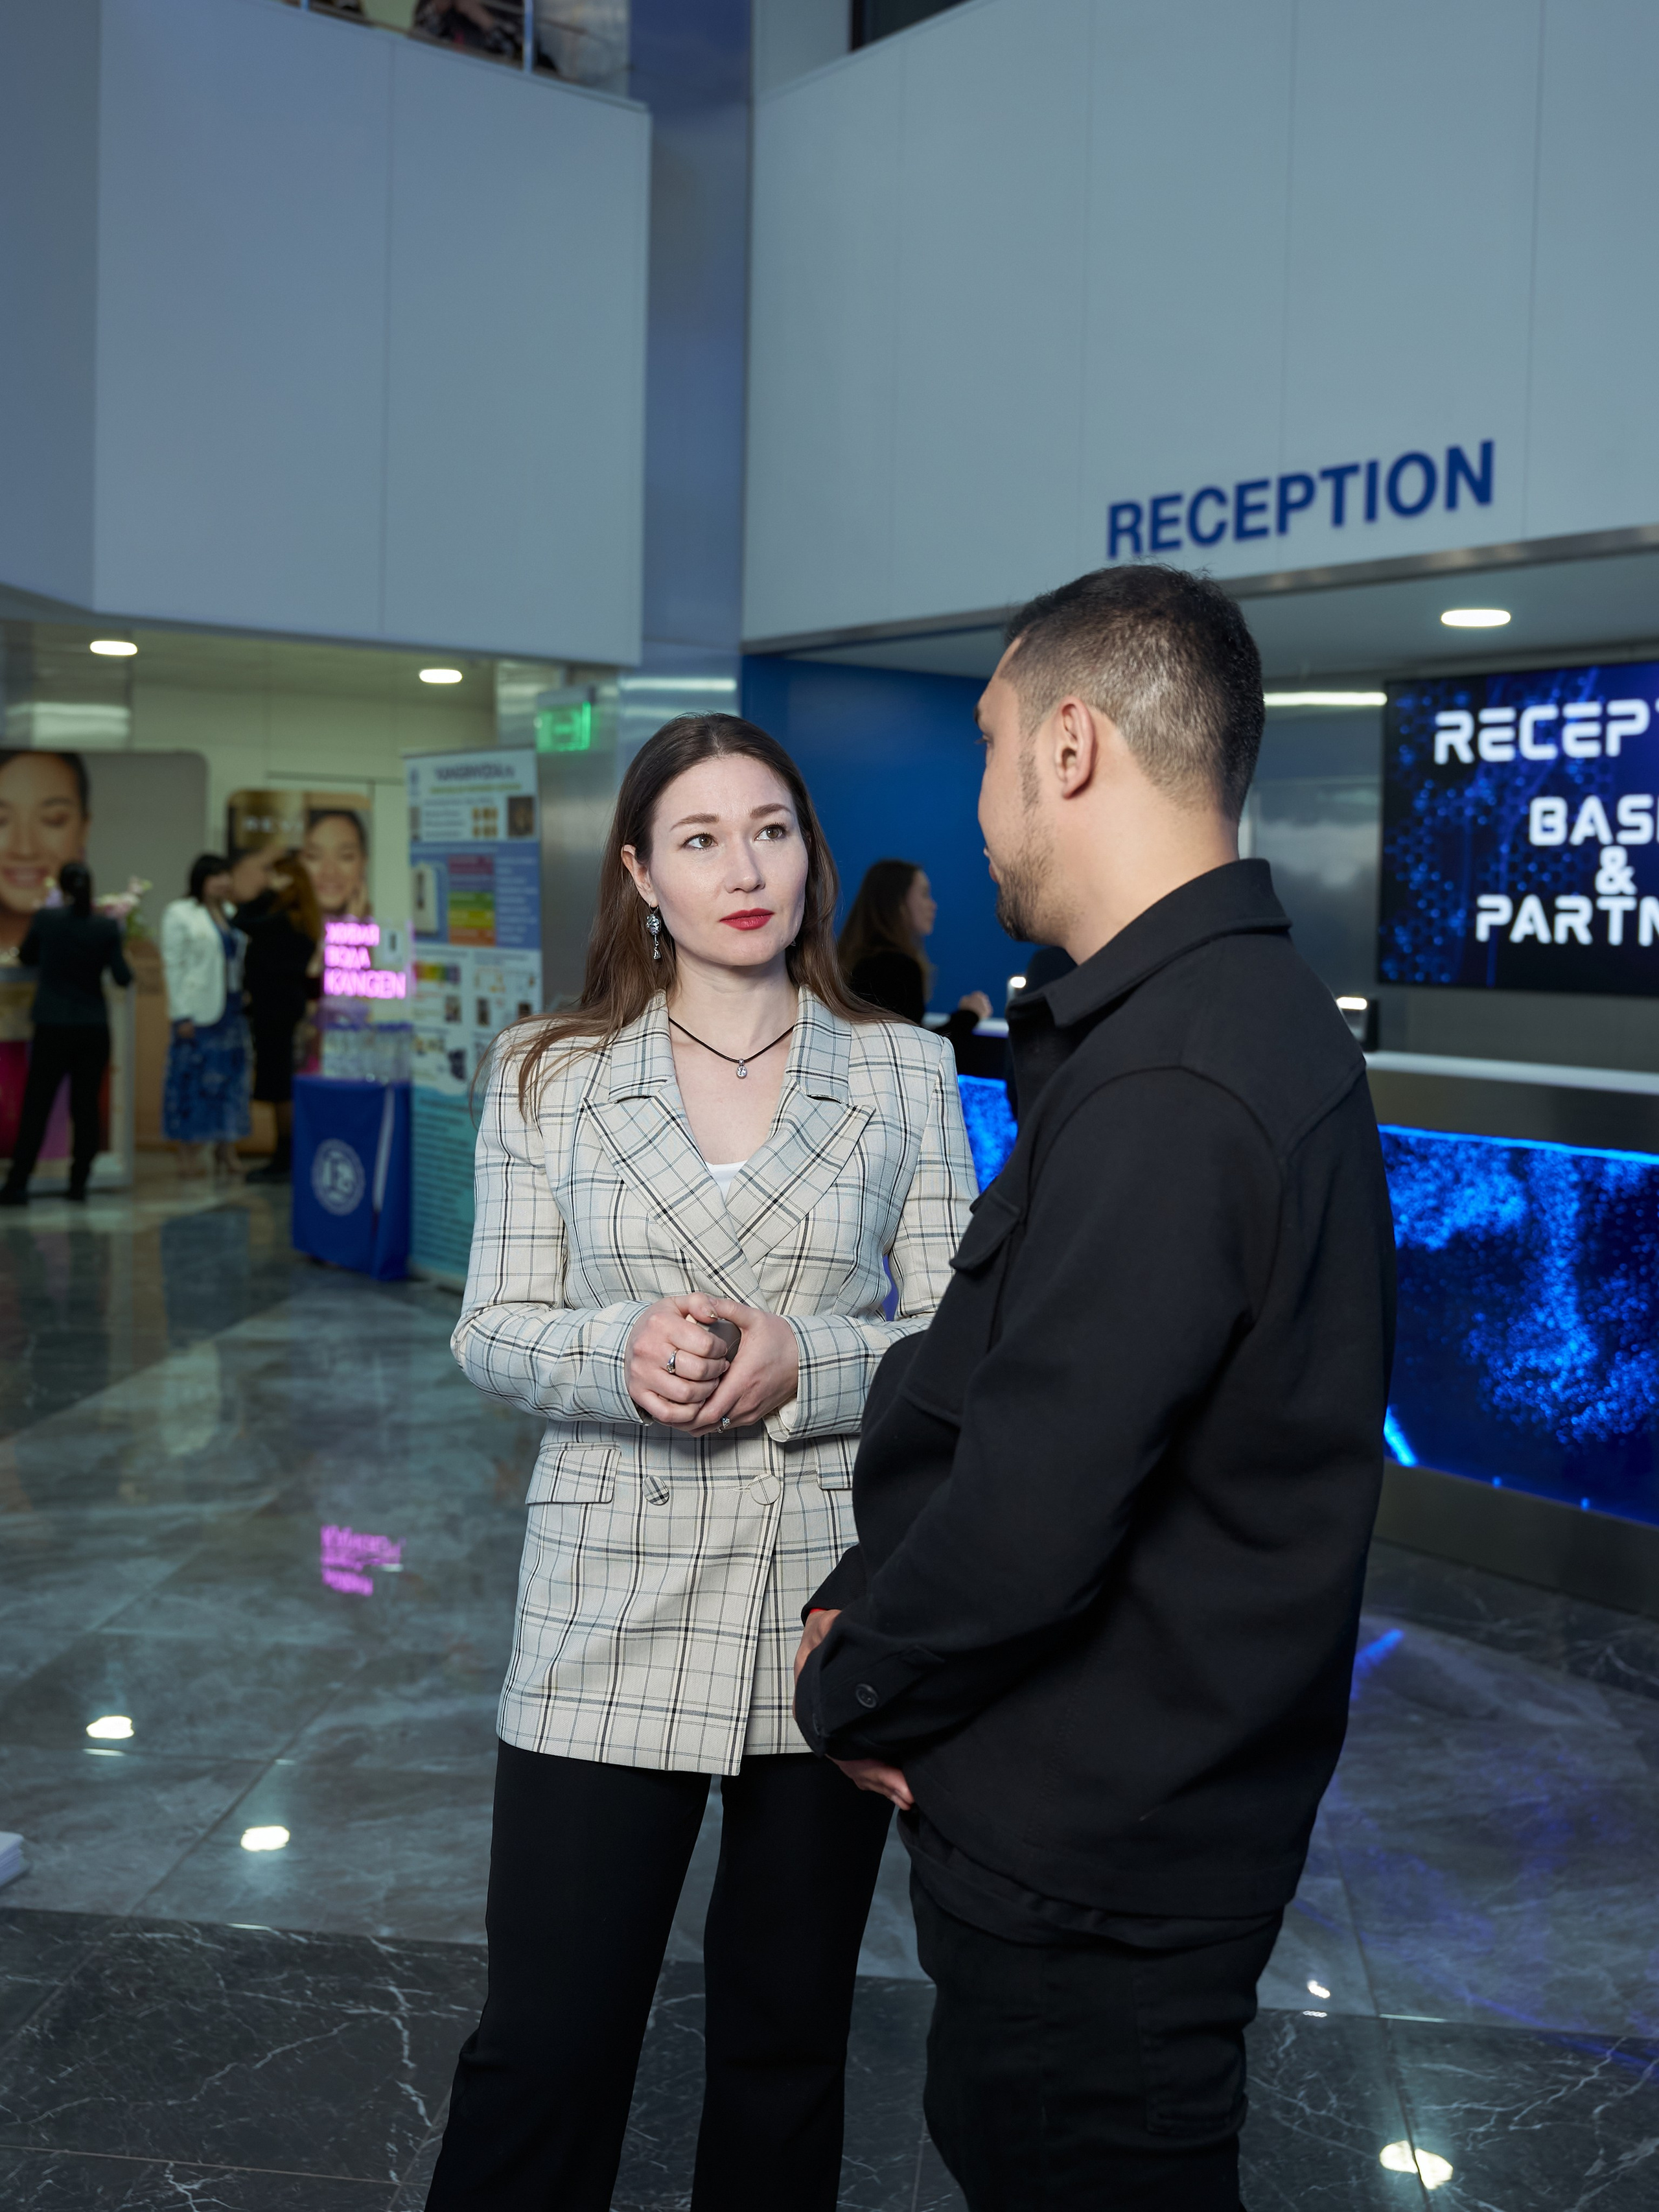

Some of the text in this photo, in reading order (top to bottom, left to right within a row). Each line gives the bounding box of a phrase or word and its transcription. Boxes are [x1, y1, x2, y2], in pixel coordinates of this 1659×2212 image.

[1107, 439, 1495, 560] RECEPTION
[1433, 697, 1659, 765] RECEP
[1529, 793, 1659, 846] BAS
[1595, 845, 1638, 896] &
[324, 968, 406, 999] KANGEN
